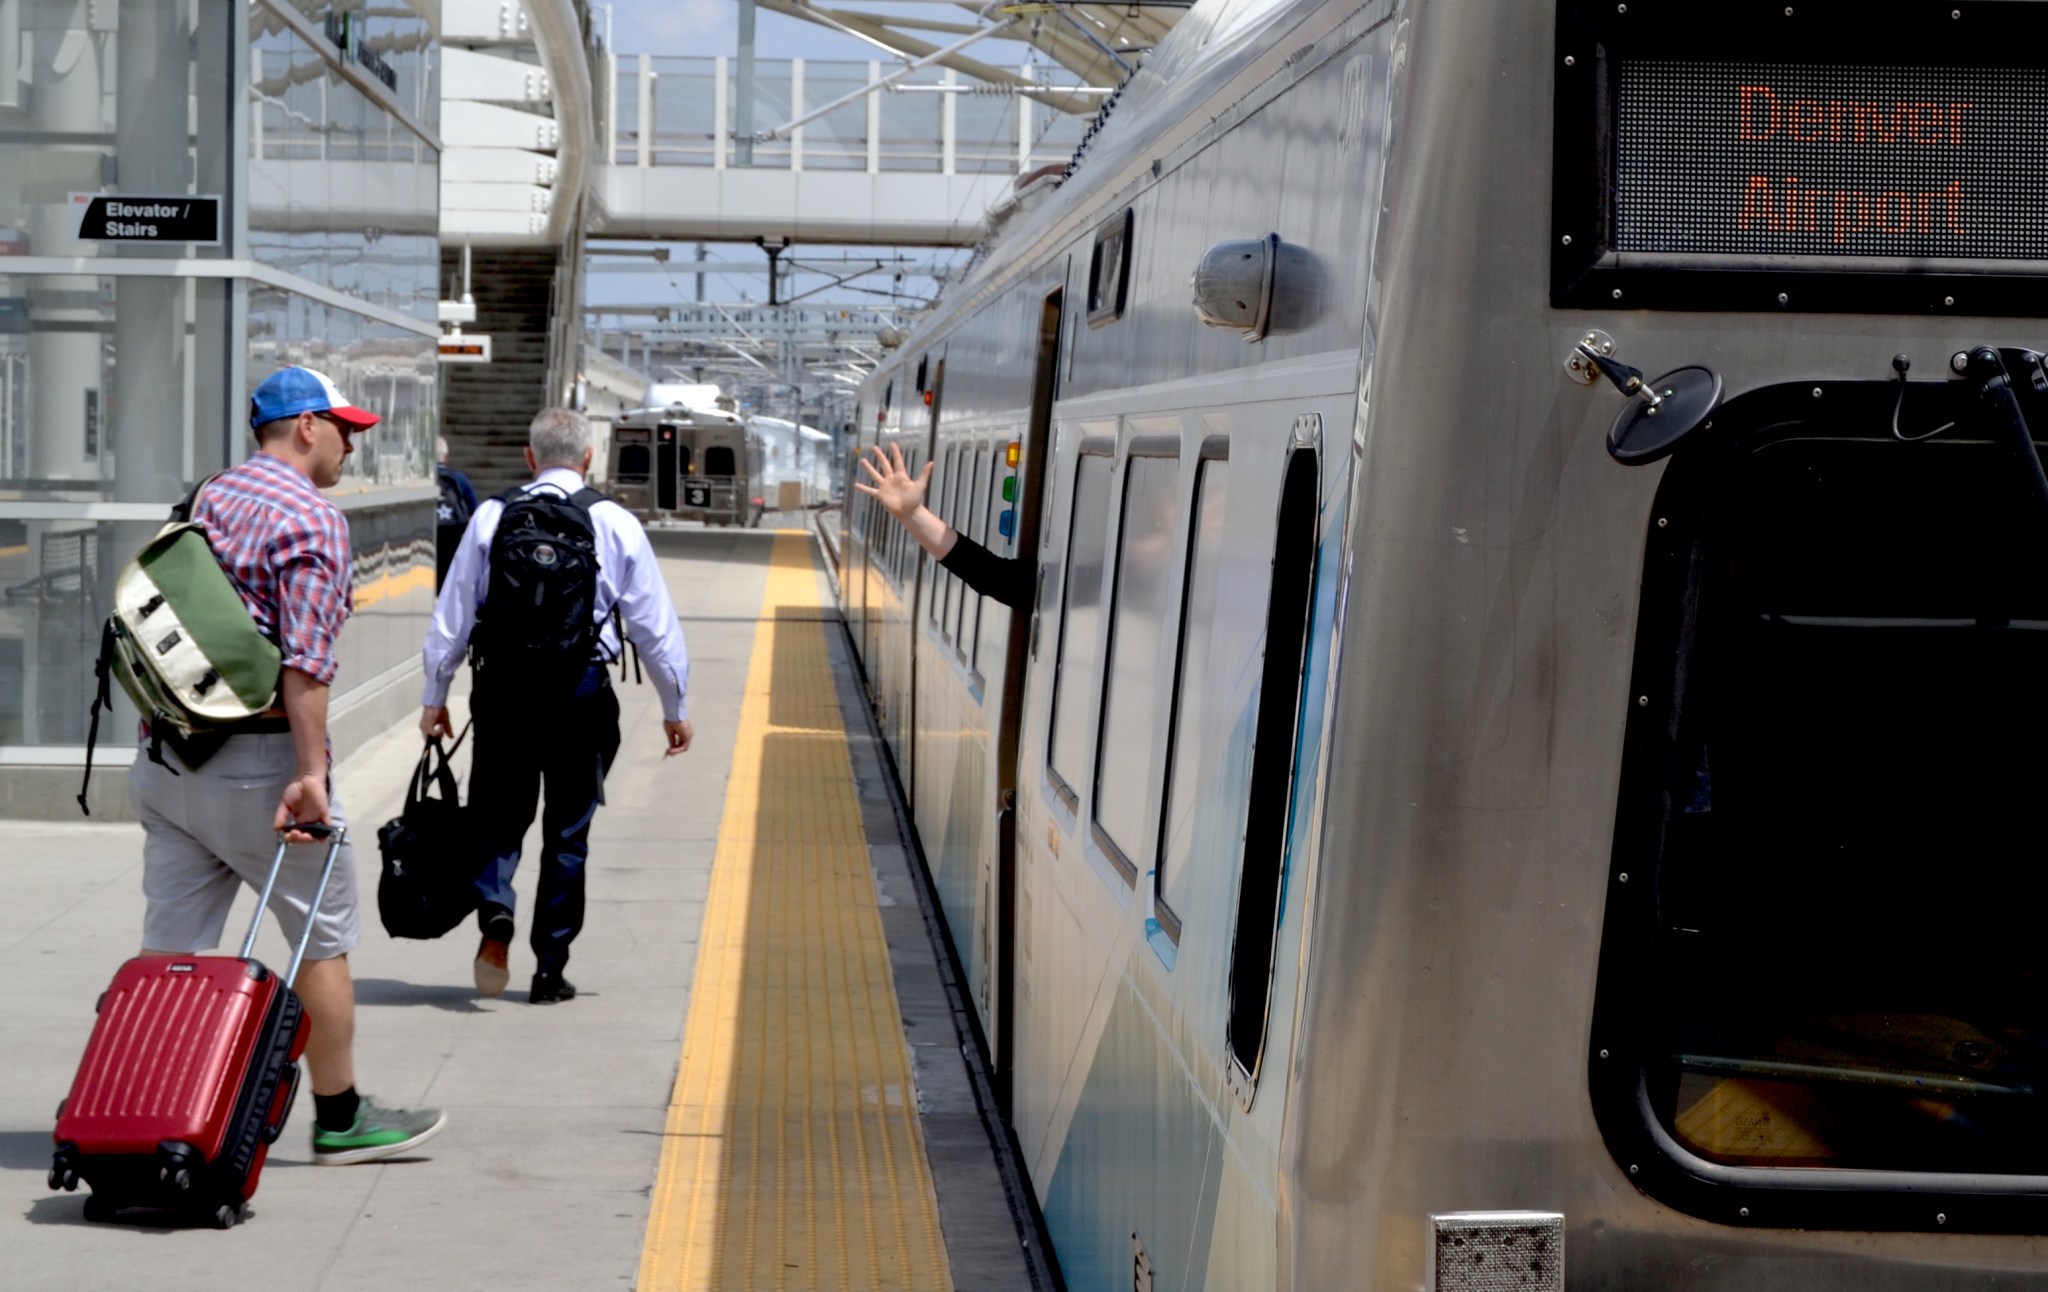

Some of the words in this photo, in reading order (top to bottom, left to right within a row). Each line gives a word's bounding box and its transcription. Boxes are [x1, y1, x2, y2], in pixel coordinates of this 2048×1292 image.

[1740, 86, 1974, 144] Denver
[106, 202, 179, 218] Elevator
[1738, 176, 1966, 243] Airport
[105, 221, 158, 237] Stairs
[691, 489, 705, 505] 3
